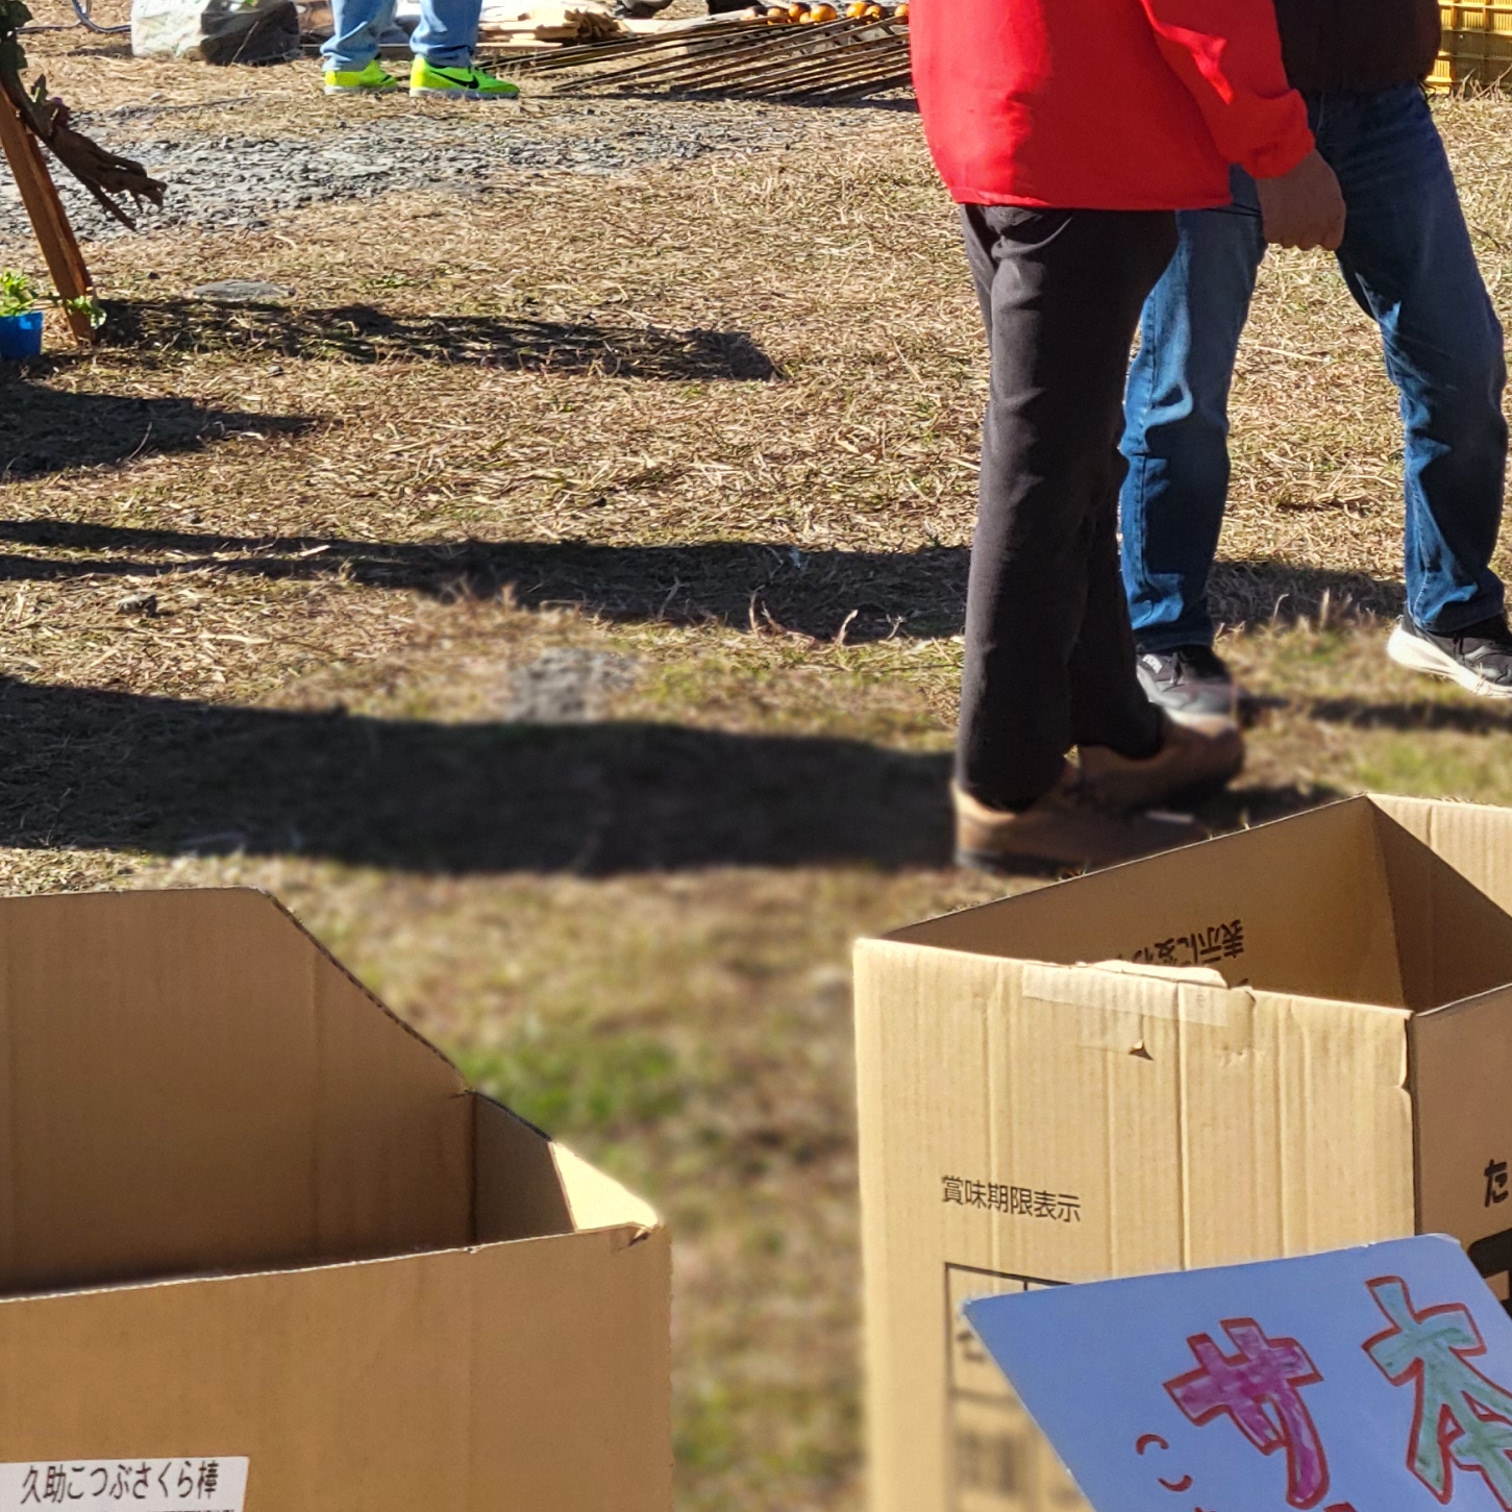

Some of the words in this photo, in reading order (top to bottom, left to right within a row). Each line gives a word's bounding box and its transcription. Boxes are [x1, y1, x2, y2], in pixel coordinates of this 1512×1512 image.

[941, 1174, 1081, 1223] 賞味期限表示
[20, 1460, 220, 1505] 久助こつぶさくら棒
